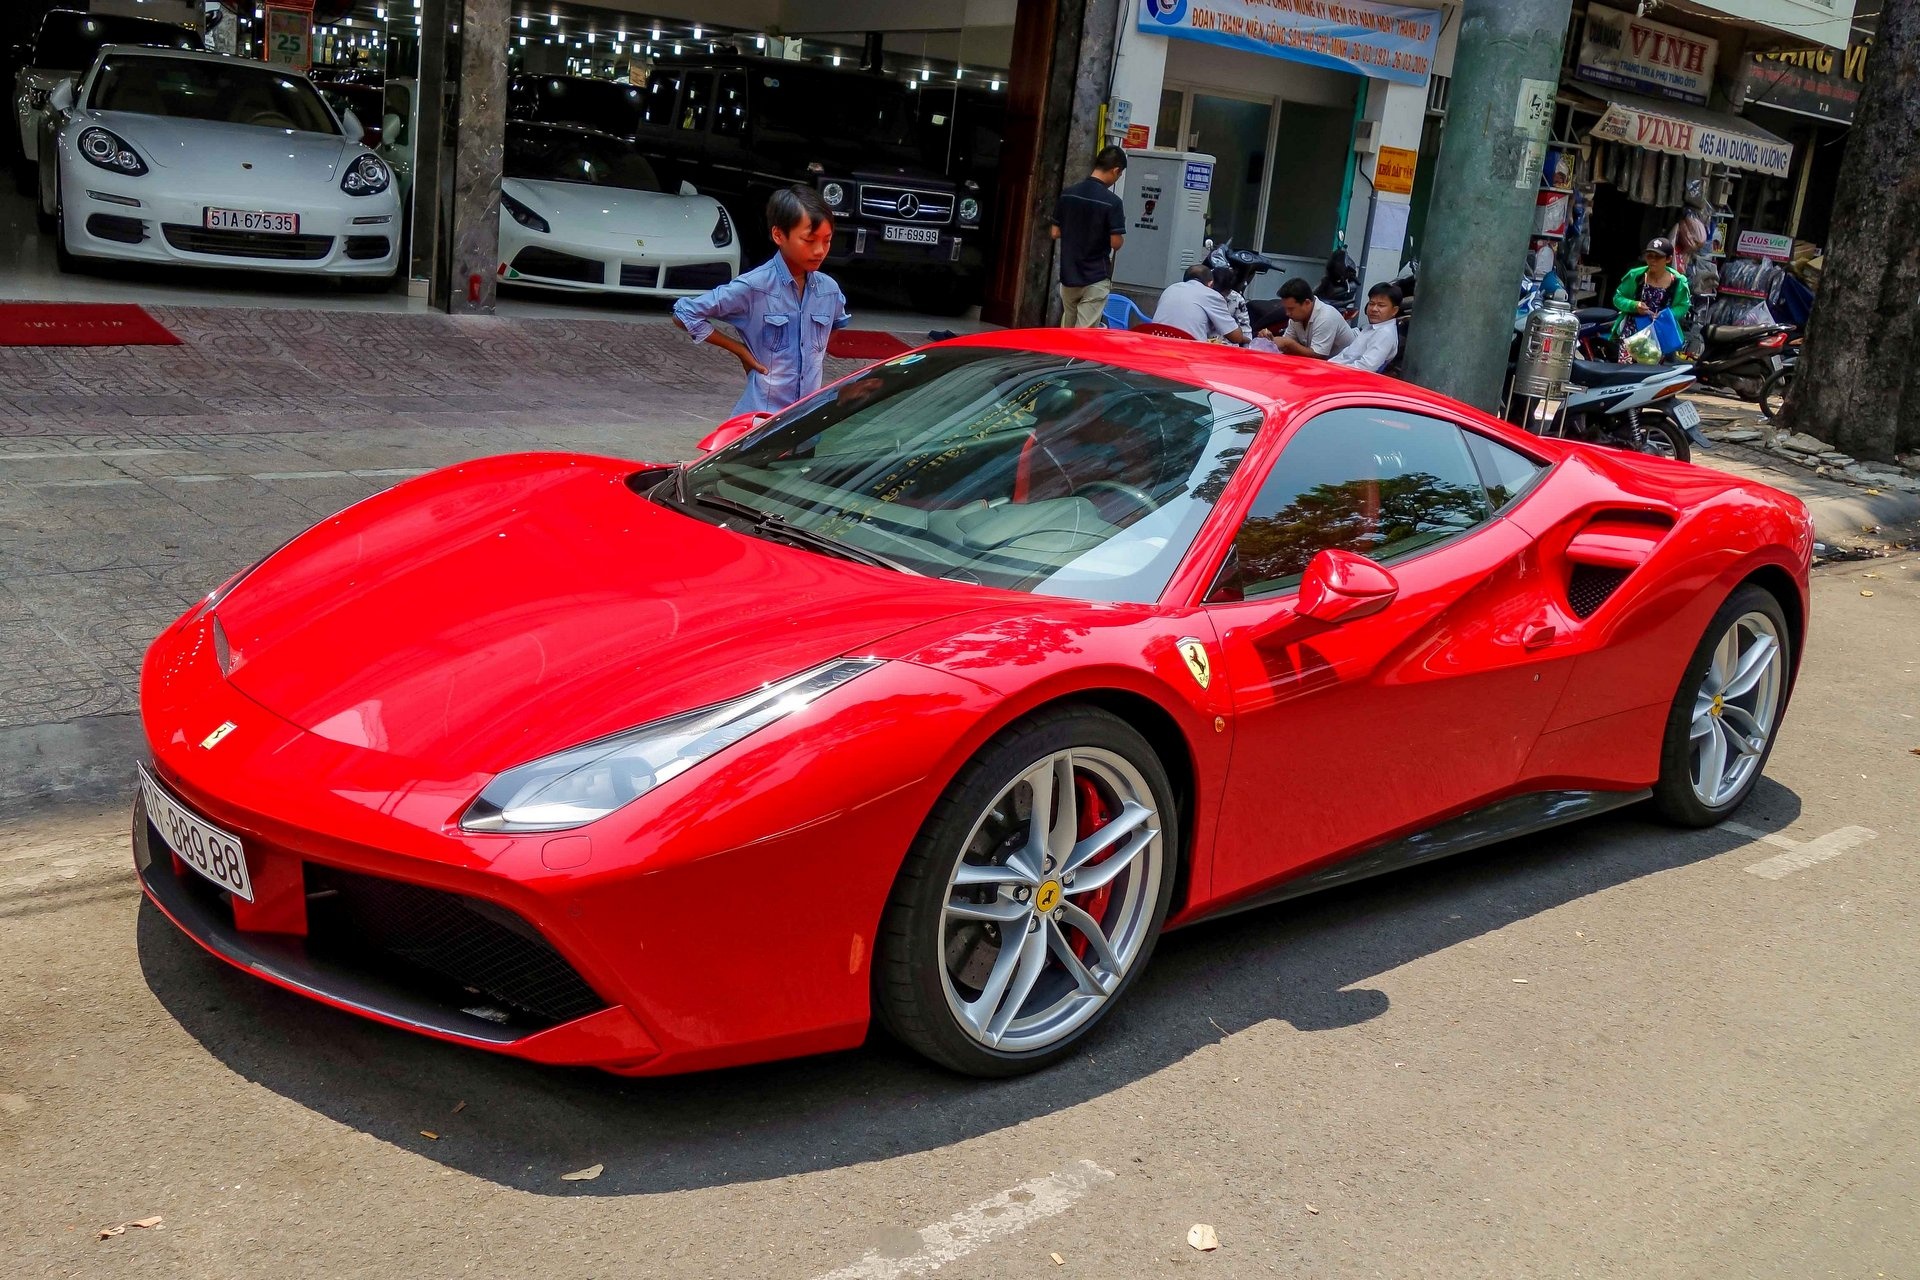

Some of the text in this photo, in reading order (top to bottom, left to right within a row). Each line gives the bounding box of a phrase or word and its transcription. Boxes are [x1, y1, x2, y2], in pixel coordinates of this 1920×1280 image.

[277, 32, 301, 53] 25
[1629, 23, 1710, 76] VINH
[1635, 114, 1695, 151] VINH
[1698, 132, 1788, 171] 465 AN DƯƠNG VƯƠNG
[211, 210, 293, 232] 51A-675.35
[886, 226, 938, 243] 51F-699.99
